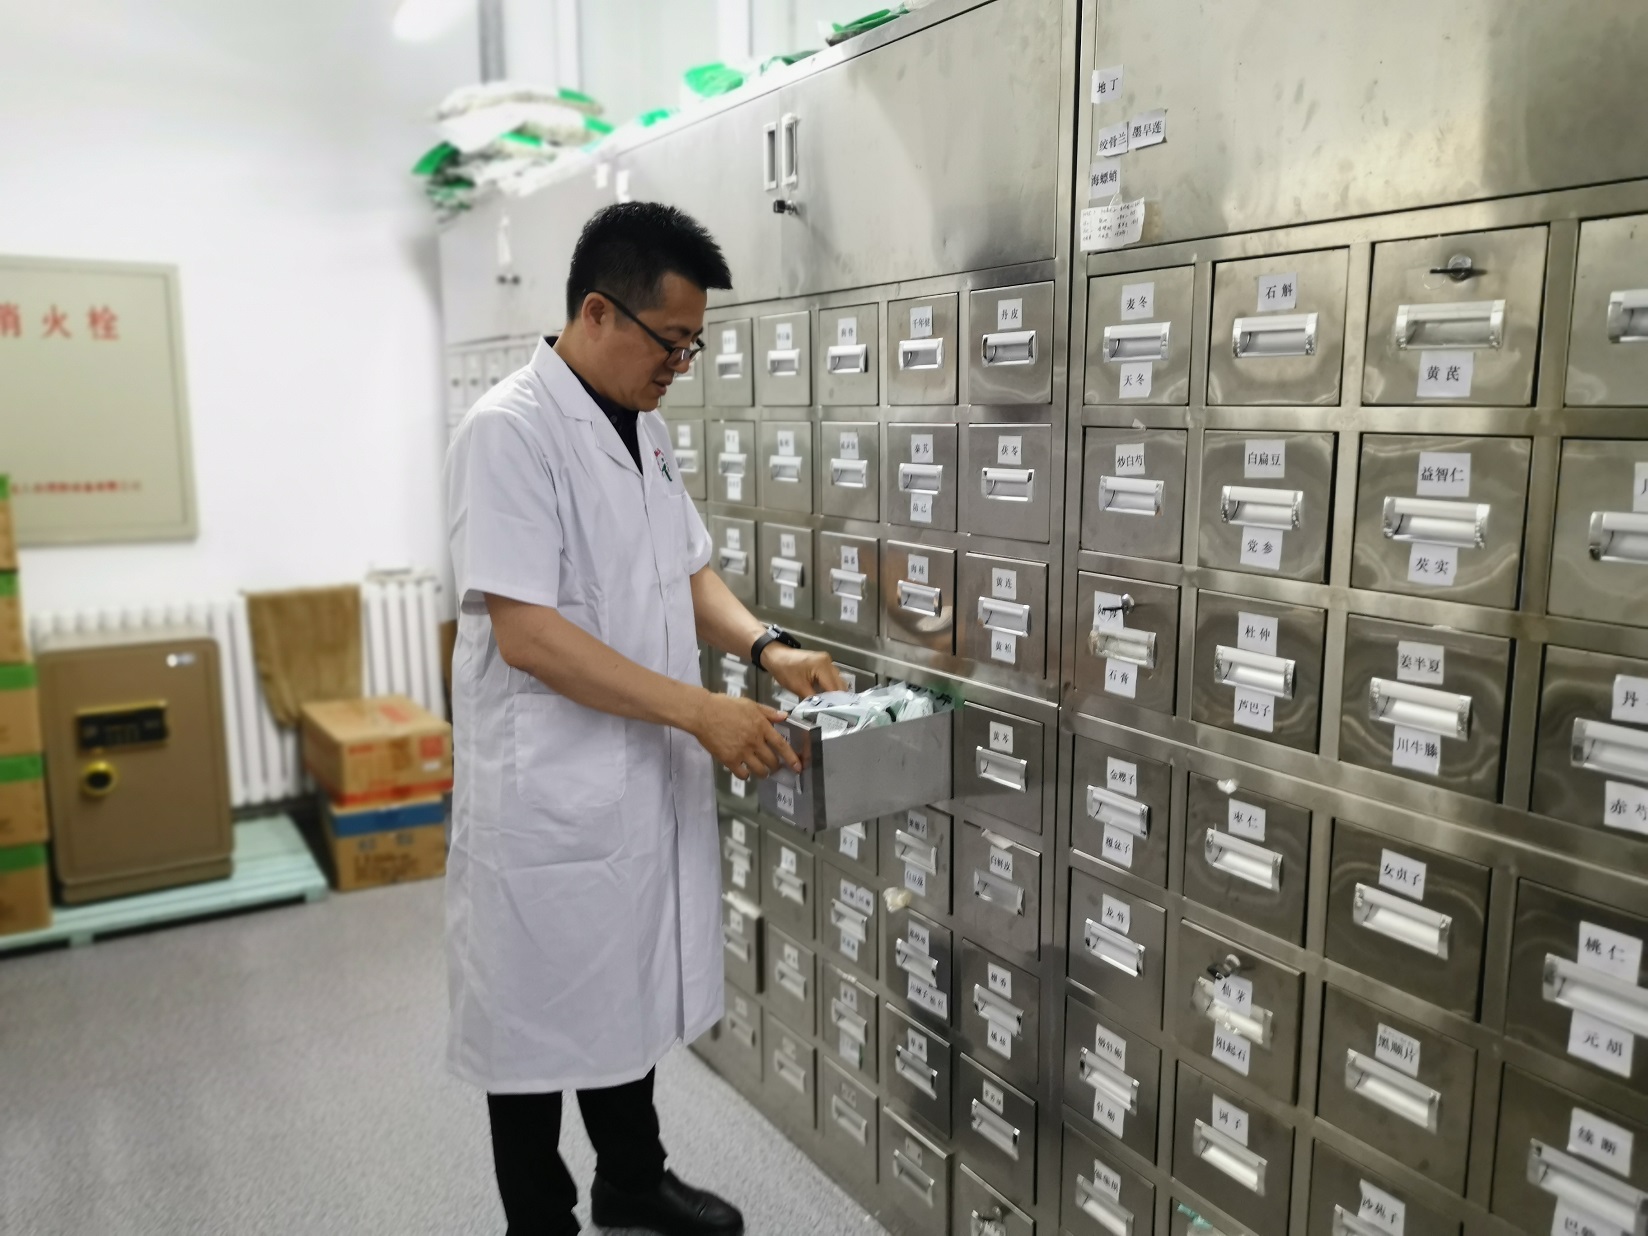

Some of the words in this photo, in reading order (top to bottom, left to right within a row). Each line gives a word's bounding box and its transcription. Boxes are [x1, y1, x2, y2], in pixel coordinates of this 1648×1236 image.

[1097, 77, 1119, 94] 地丁
[1091, 169, 1118, 187] 海螵蛸
[1265, 282, 1293, 299] 石斛
[1126, 295, 1148, 311] 麦冬
[0, 302, 120, 341] 消火栓
[1001, 307, 1019, 320] 丹皮
[913, 317, 931, 329] 千年健
[1123, 373, 1145, 388] 天冬
[1425, 365, 1460, 382] 黄芪
[1001, 444, 1019, 456] 茯苓
[1117, 453, 1144, 469] 炒白芍
[1247, 451, 1282, 467] 白扁豆
[1420, 466, 1465, 483] 益智仁
[1246, 538, 1274, 555] 党参
[1416, 556, 1449, 575] 芡实
[996, 576, 1013, 589] 黄连
[1244, 624, 1271, 642] 杜仲
[995, 640, 1012, 653] 黄柏
[1400, 653, 1441, 674] 姜半夏
[1108, 668, 1129, 685] 石膏
[992, 730, 1009, 744] 黄芩
[1396, 736, 1438, 759] 川牛膝
[1610, 798, 1648, 822] 赤芍
[1382, 862, 1423, 887] 女贞子
[1584, 936, 1626, 963] 桃仁
[1583, 1030, 1624, 1057] 元胡
[1577, 1125, 1617, 1157] 续断
